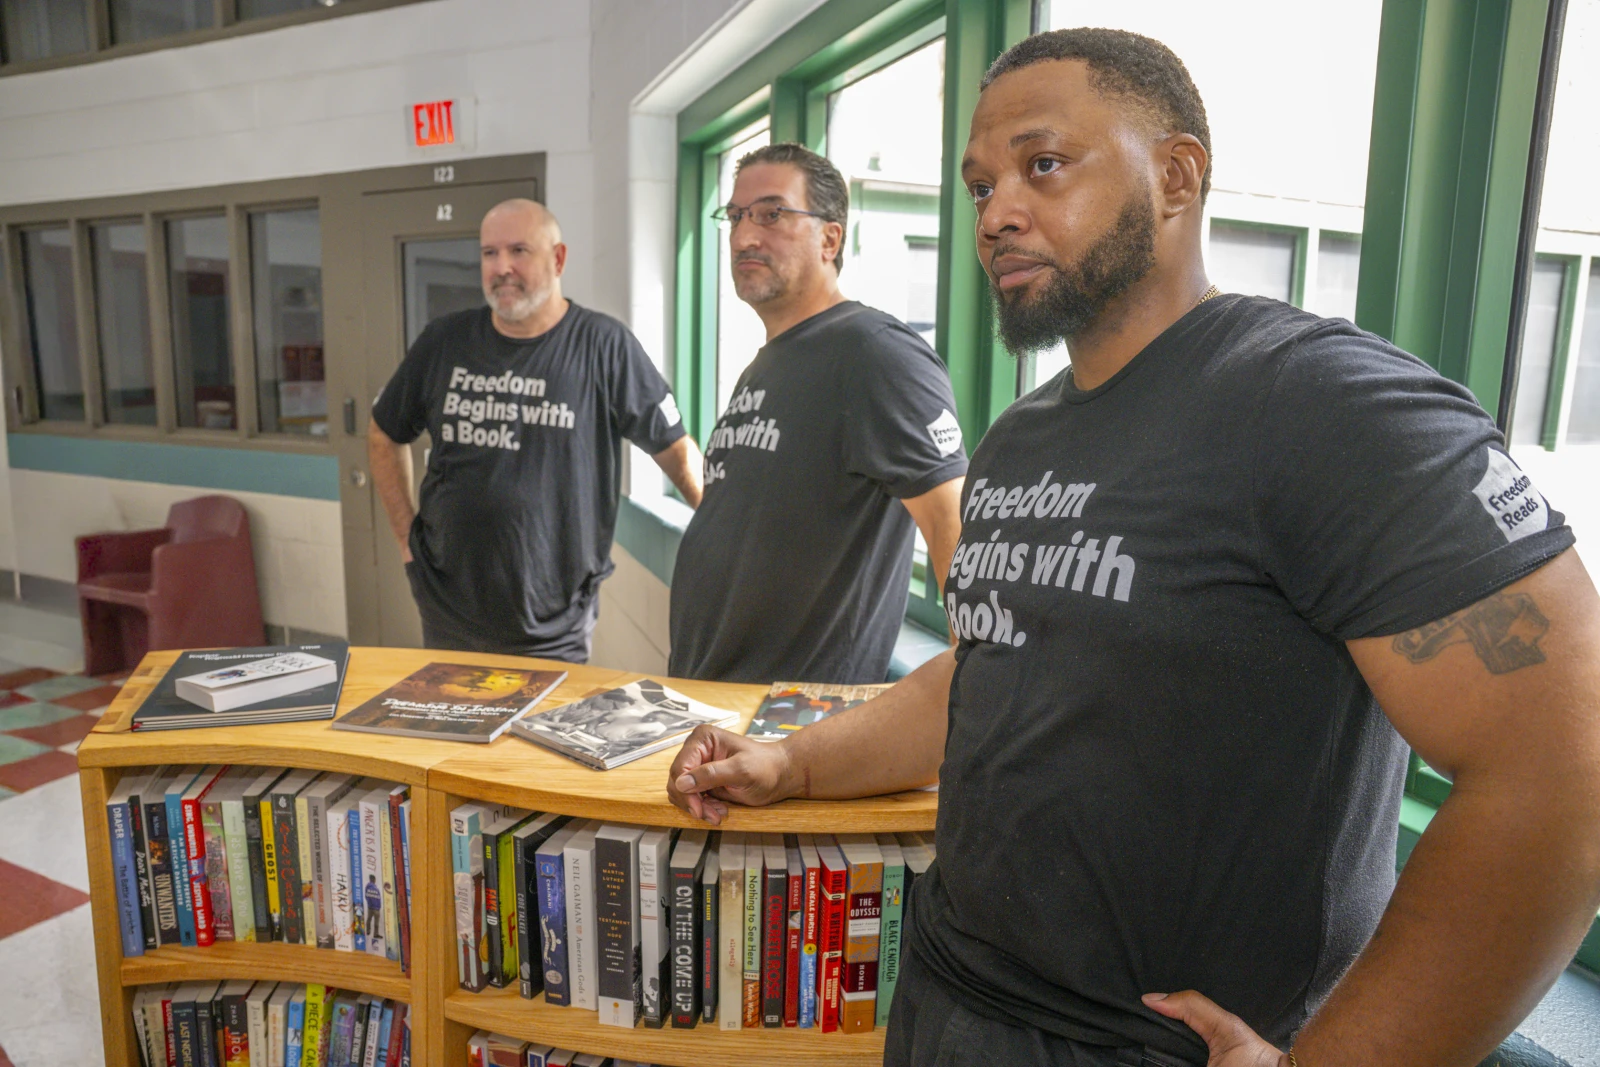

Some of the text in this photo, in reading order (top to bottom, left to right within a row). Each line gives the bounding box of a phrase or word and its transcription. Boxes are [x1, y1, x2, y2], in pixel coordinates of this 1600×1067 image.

[413, 100, 455, 147] EXIT
[433, 165, 455, 183] 123
[436, 203, 453, 221] A2
[449, 366, 546, 397] Freedom
[443, 392, 575, 429] Begins with
[442, 420, 521, 452] a Book.
[735, 416, 781, 452] with
[963, 470, 1097, 523] Freedom
[1488, 475, 1532, 512] Freedom
[1502, 496, 1539, 530] Reads
[950, 529, 1136, 602] egins with
[112, 807, 125, 839] DRAPER
[364, 807, 374, 834] ANGER
[136, 851, 146, 874] Dear
[266, 844, 276, 882] GHOST
[312, 818, 320, 850] SELECTED
[316, 874, 322, 882] OF
[366, 856, 377, 872] GIFT
[178, 837, 184, 847] AM
[183, 884, 192, 912] PERFECT
[337, 874, 348, 912] HAIKU
[486, 888, 498, 926] FAKE ID
[574, 882, 582, 924] GAIMAN
[676, 886, 692, 908] ON
[859, 898, 872, 906] THE
[196, 909, 206, 930] WARD
[598, 917, 630, 926] TESTAMENT
[676, 913, 692, 940] THE
[746, 876, 758, 966] Nothing to See Here
[828, 874, 842, 963] COLSON WHITEHEAD
[850, 907, 880, 918] ODYSSEY
[766, 895, 783, 999] CONCRETE ROSE
[886, 920, 898, 982] BLACK ENOUGH
[676, 946, 692, 988] COME
[308, 1003, 318, 1031] PIECE
[676, 993, 692, 1012] UP
[180, 1022, 190, 1038] LAST
[182, 1040, 192, 1062] NIGHT
